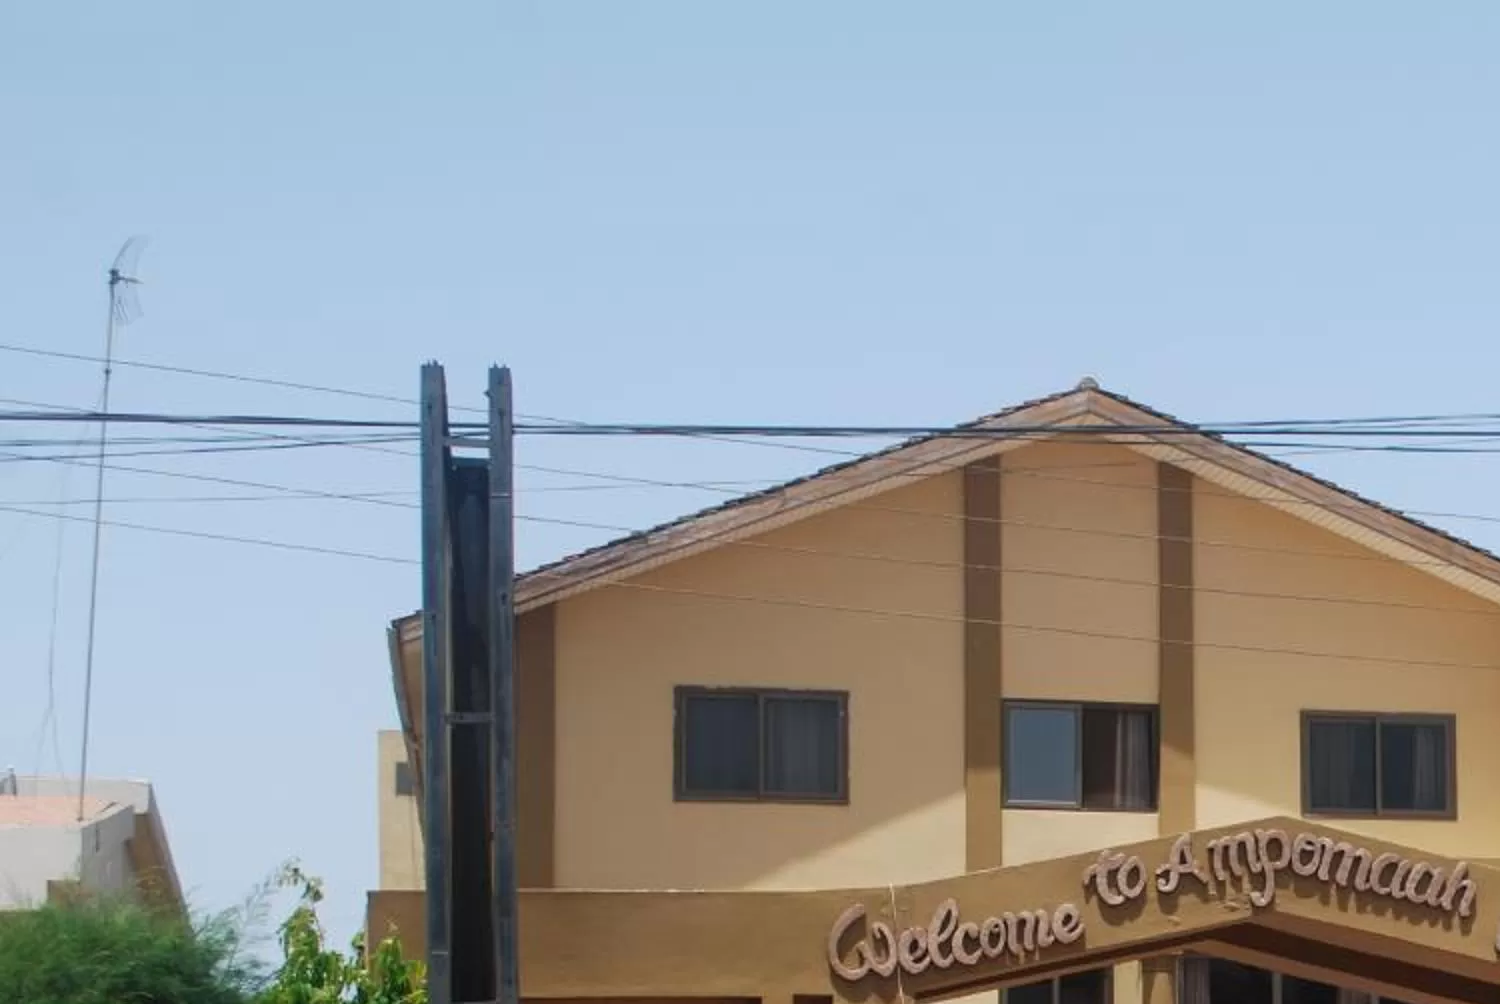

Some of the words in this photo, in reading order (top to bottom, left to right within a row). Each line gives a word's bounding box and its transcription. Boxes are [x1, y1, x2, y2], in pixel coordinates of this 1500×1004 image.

[828, 898, 1086, 980] Welcome
[1083, 849, 1147, 905] to
[1155, 830, 1477, 917] Ampomaah
